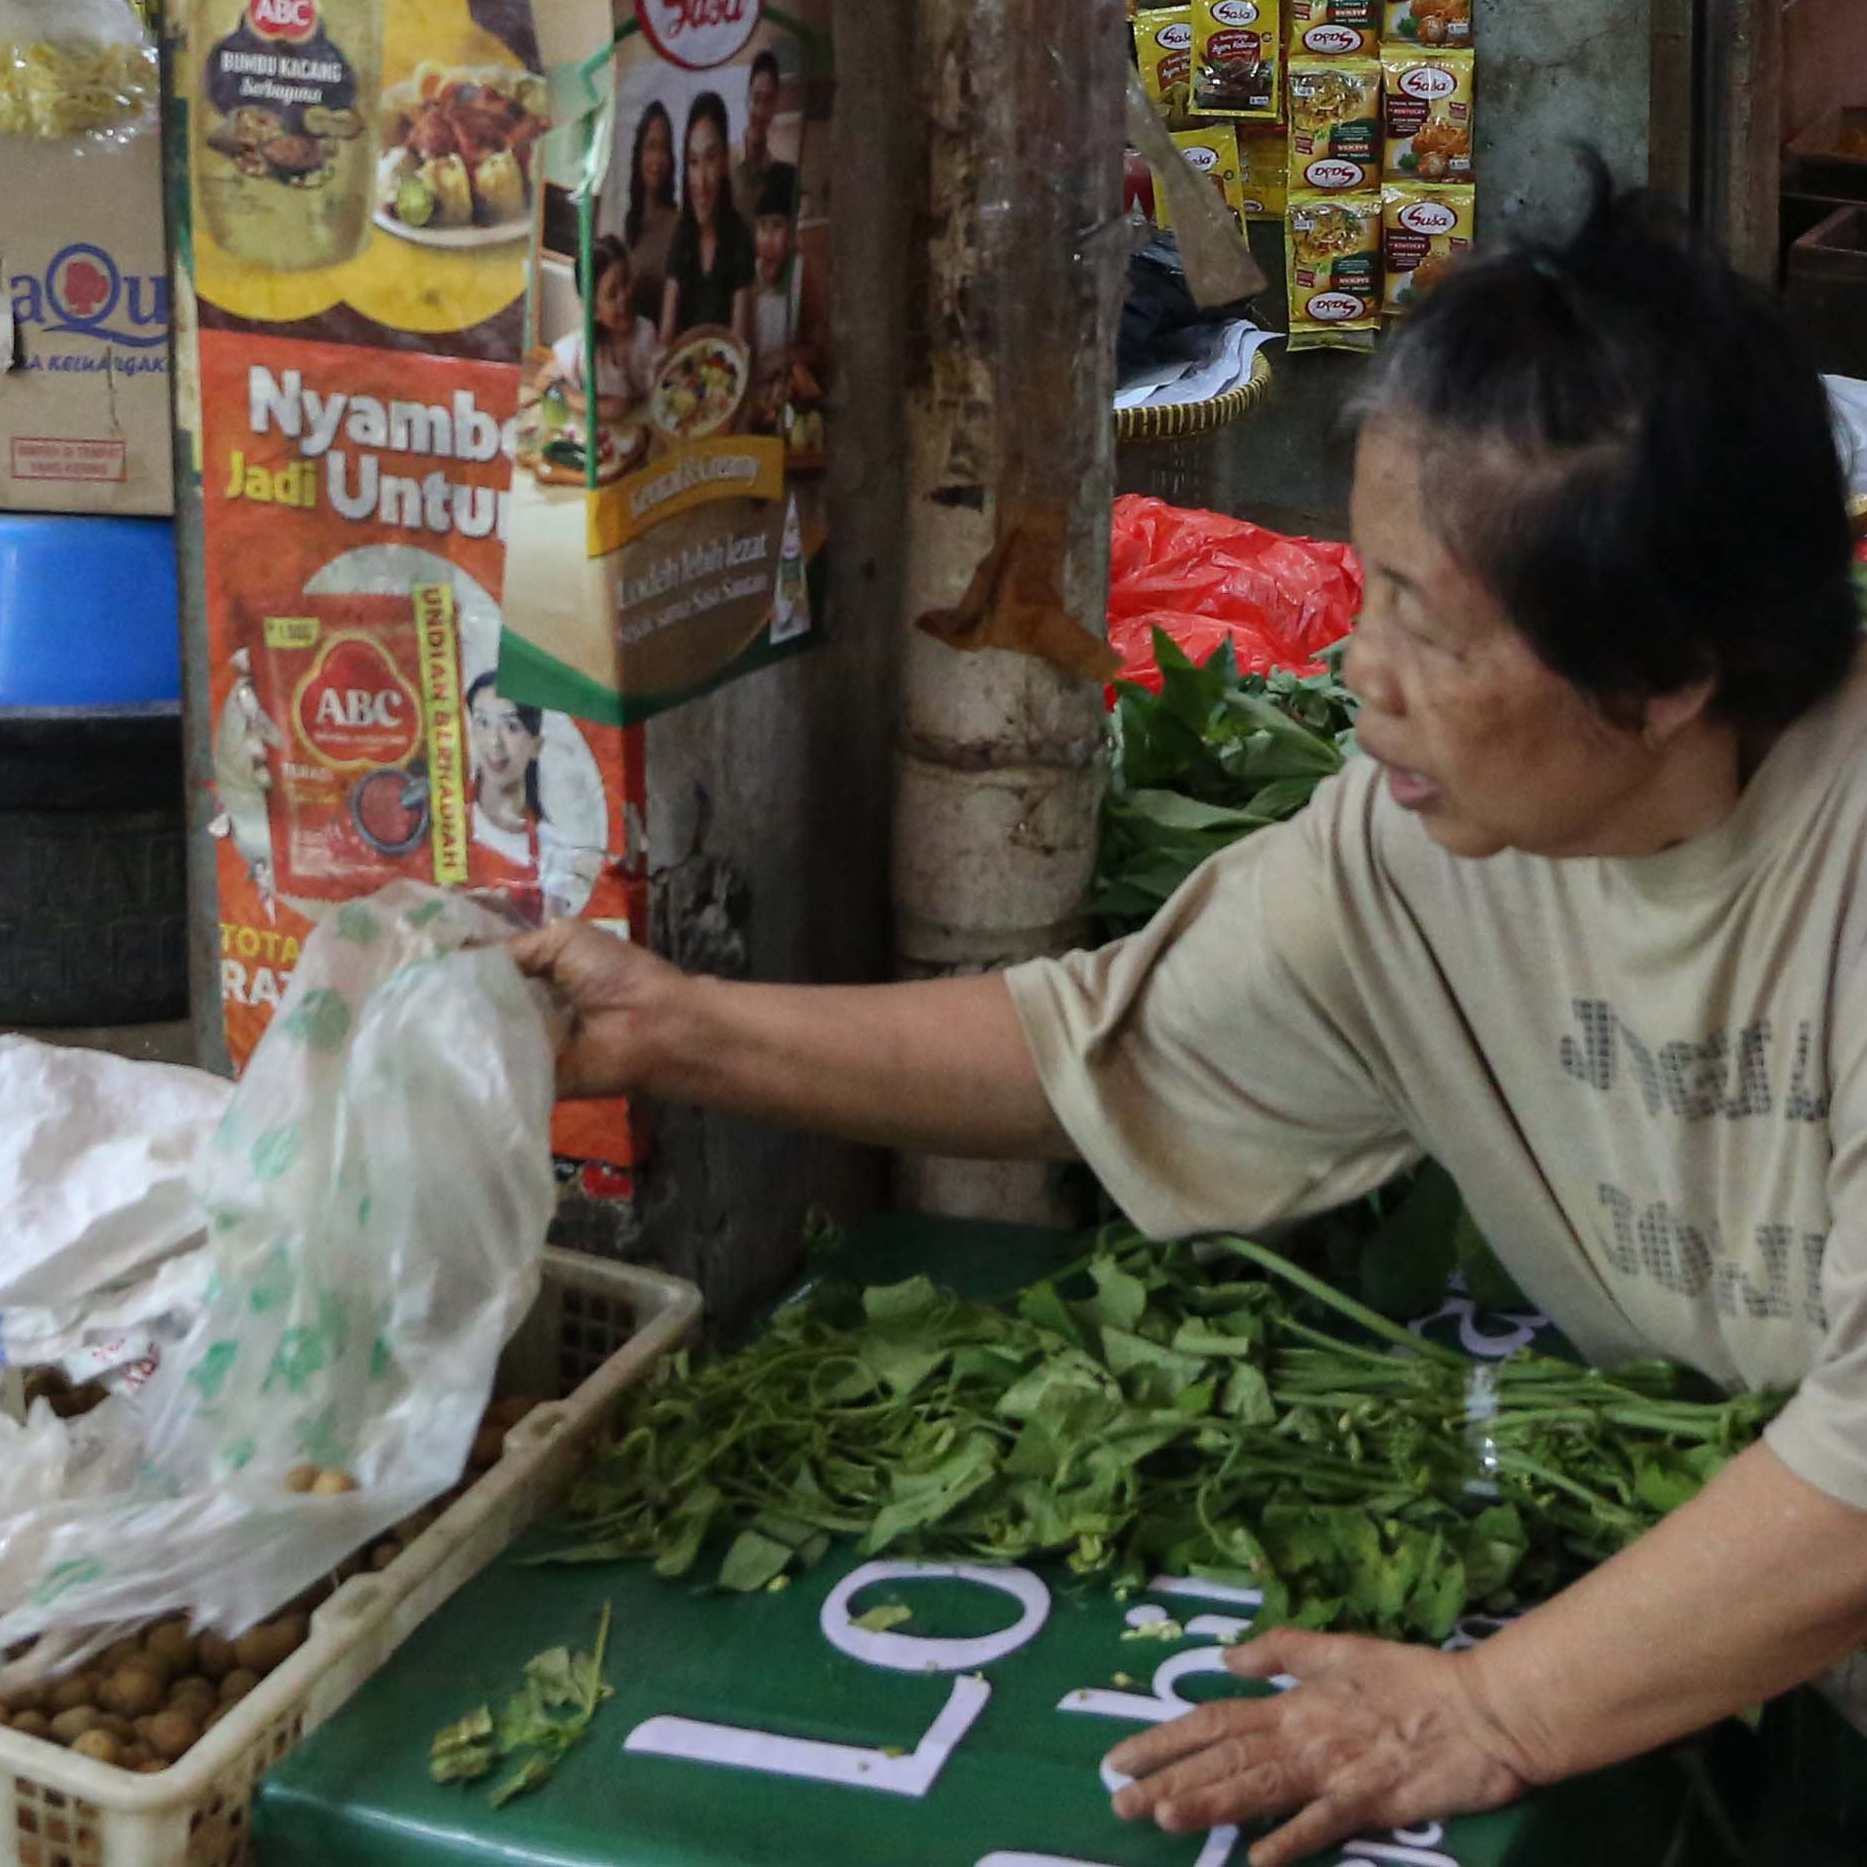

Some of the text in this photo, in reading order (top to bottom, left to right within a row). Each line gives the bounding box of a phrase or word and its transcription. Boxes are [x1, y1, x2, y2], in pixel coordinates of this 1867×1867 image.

[1219, 4, 1252, 20] Sasa
[1312, 33, 1354, 50] Sasa
[1408, 72, 1447, 92] Sasa
[1315, 168, 1355, 183] Sasa
[1316, 301, 1357, 317] Sasa
[226, 449, 501, 535] Jadi Untu
[315, 686, 403, 728] ABC
[219, 924, 301, 966] TOTA
